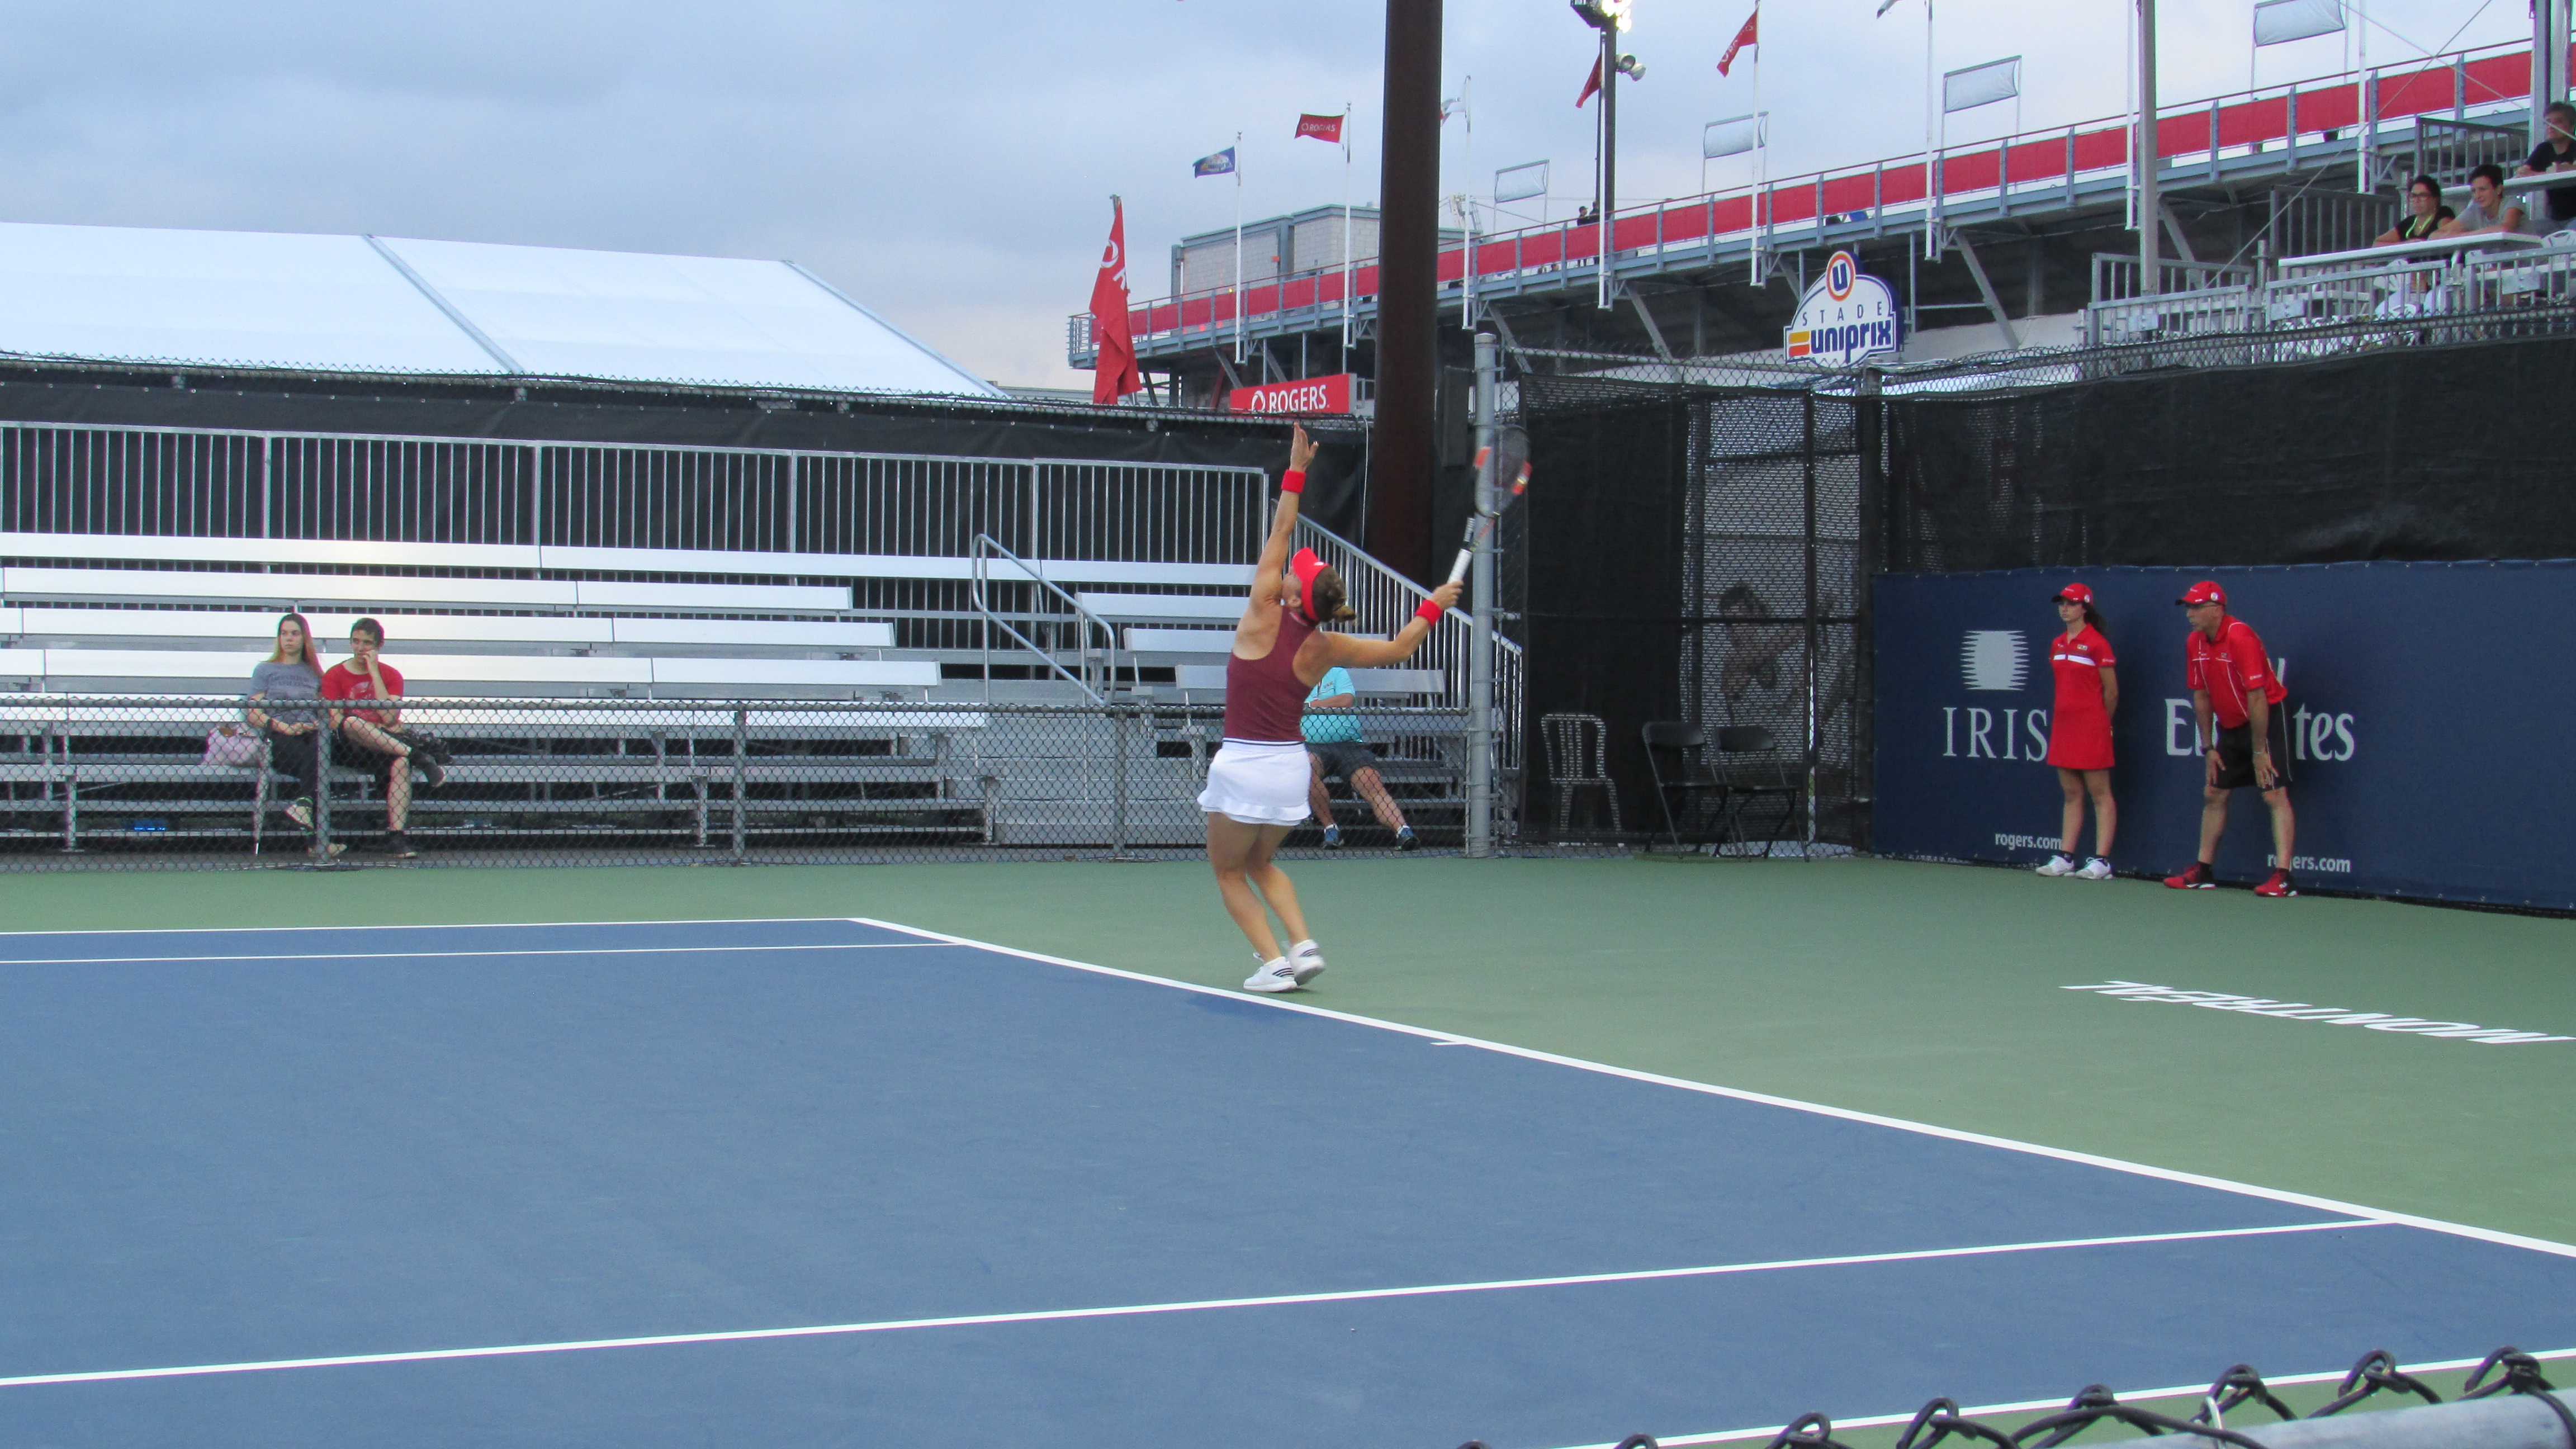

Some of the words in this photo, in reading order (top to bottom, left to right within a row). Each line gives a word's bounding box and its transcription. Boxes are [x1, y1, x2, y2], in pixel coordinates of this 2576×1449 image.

[1802, 301, 1882, 326] STADE
[1269, 384, 1327, 413] ROGERS
[1943, 707, 2048, 762] IRIS
[1995, 833, 2062, 851] rogers.com
[2267, 854, 2351, 873] rers.com
